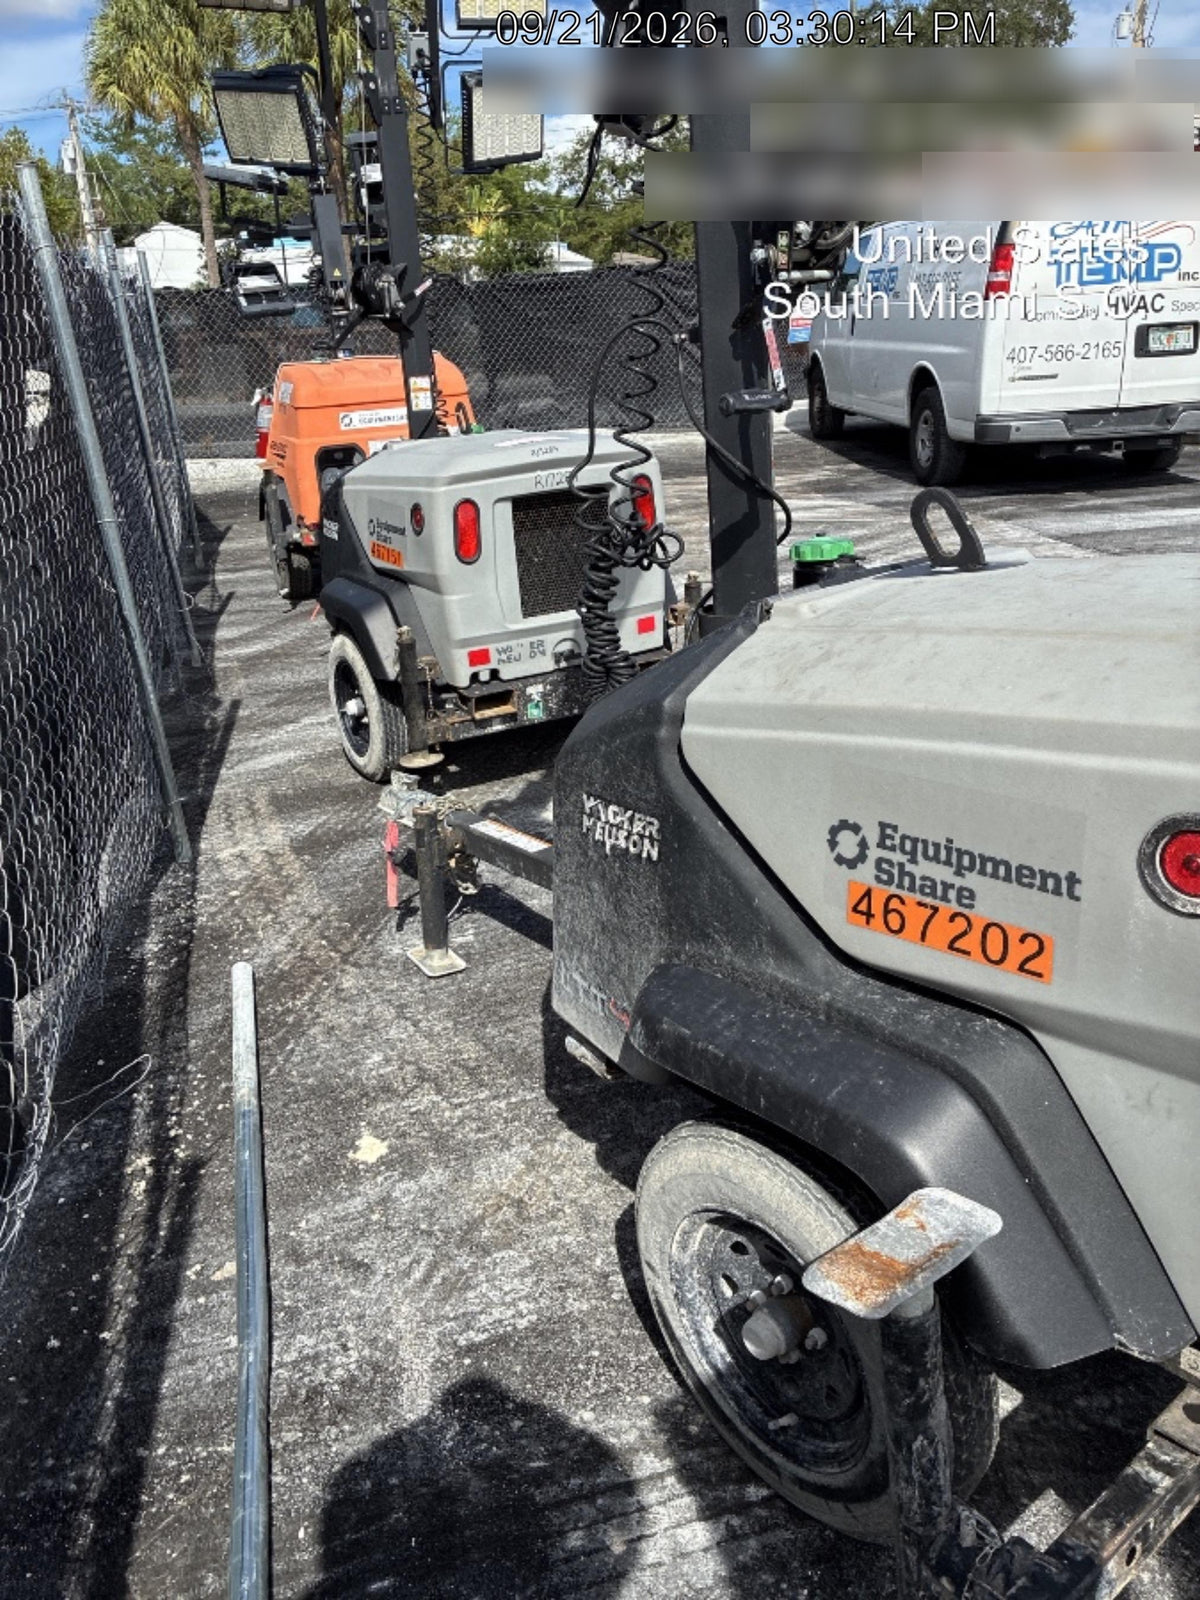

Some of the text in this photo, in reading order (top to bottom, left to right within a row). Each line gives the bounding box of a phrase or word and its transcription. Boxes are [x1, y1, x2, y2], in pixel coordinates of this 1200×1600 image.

[1006, 340, 1122, 364] 407-566-2165
[874, 855, 977, 910] Share
[876, 820, 1082, 902] Equipment
[851, 886, 1046, 979] 467202
